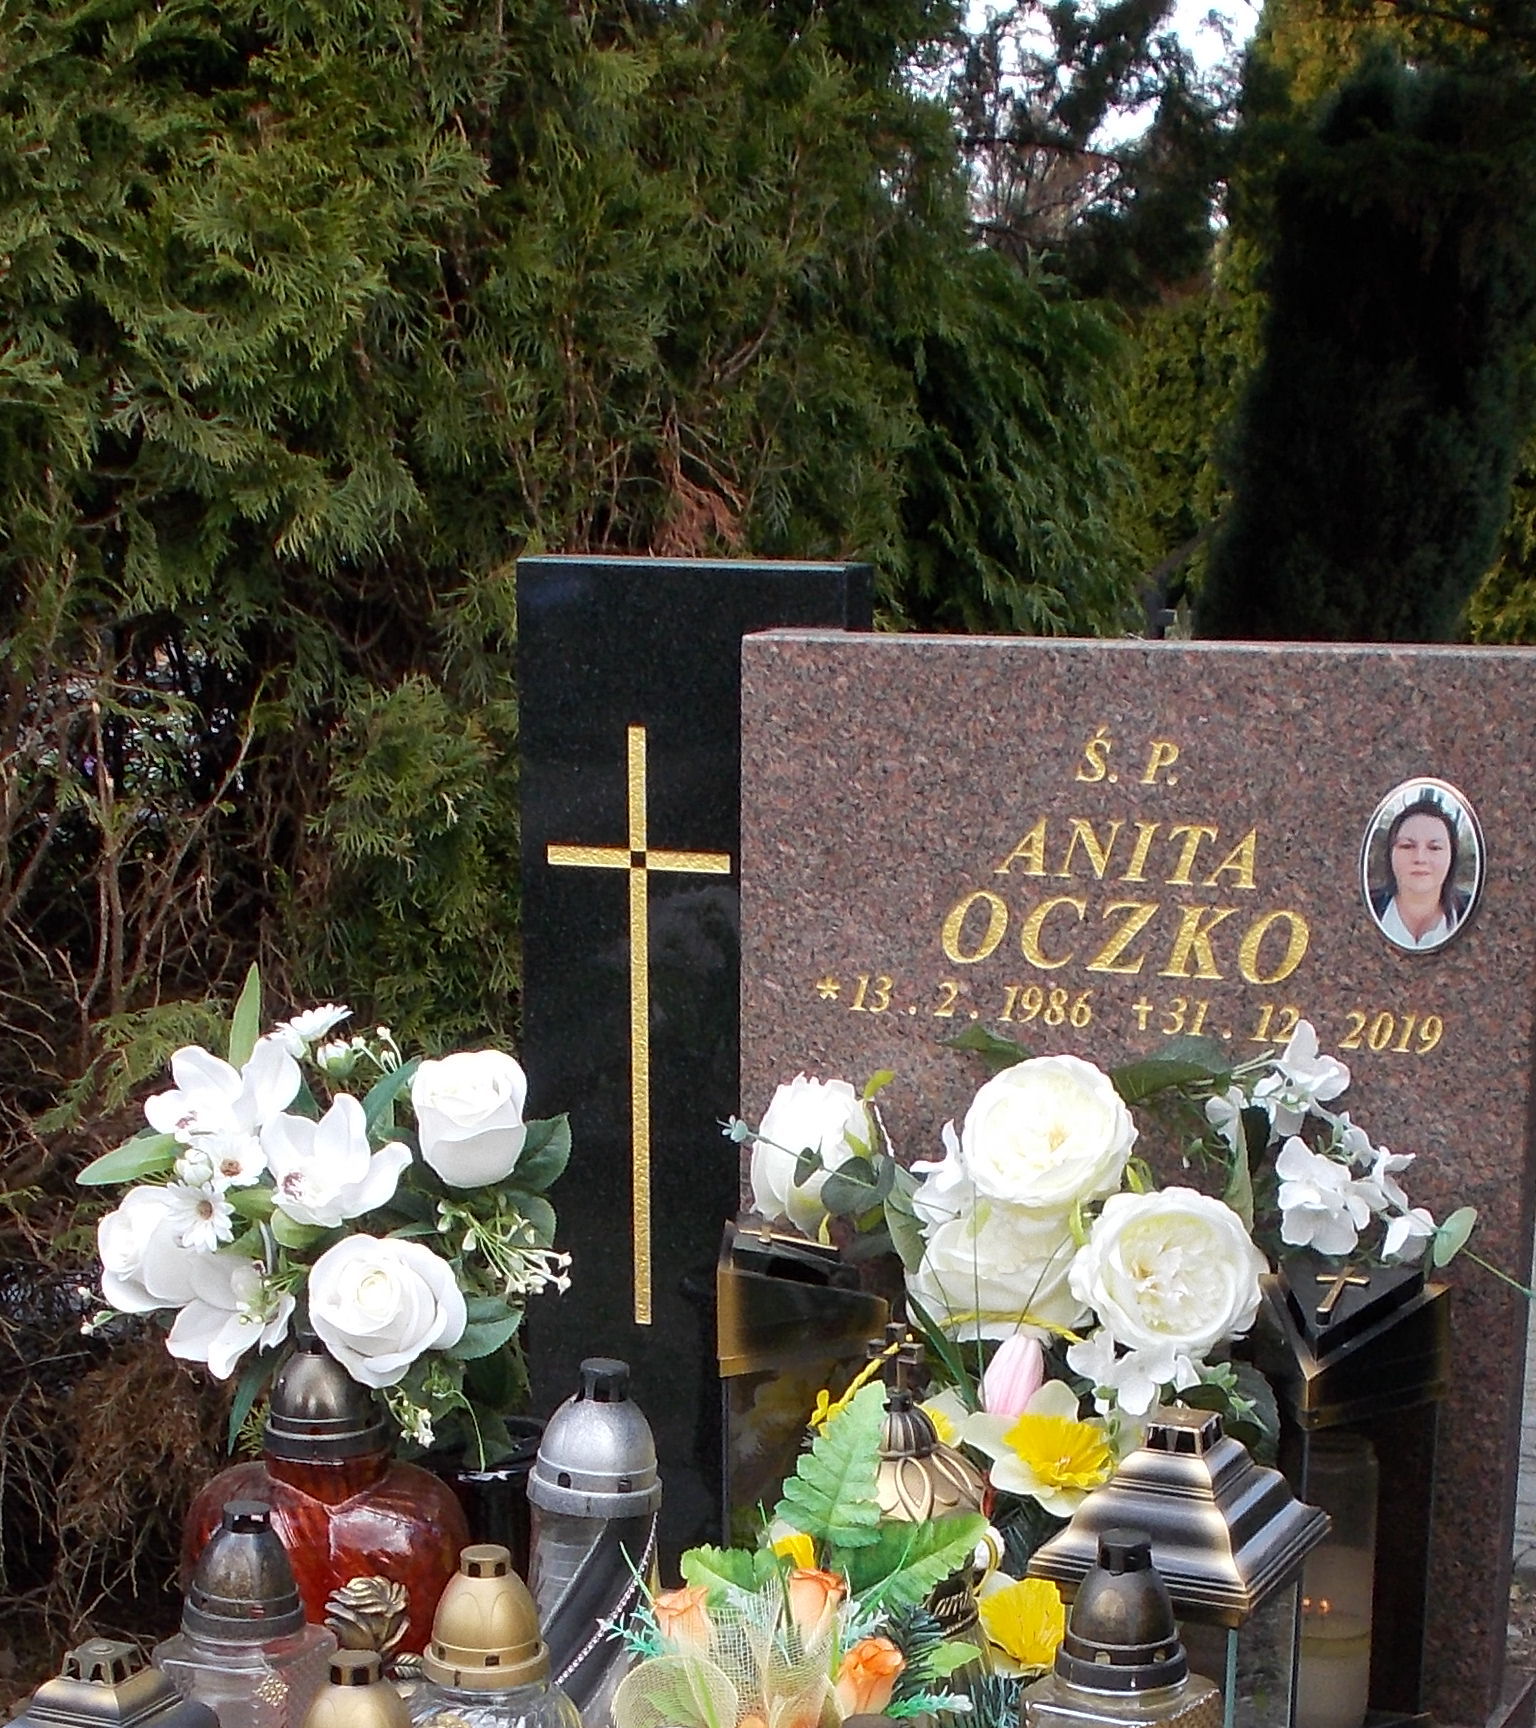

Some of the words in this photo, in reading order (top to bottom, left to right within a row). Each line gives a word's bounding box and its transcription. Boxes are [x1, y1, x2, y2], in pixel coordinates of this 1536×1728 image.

[1075, 726, 1119, 785] Ś.
[1142, 740, 1180, 787] P.
[994, 816, 1258, 890] ANITA
[940, 890, 1310, 986] OCZKO
[997, 984, 1094, 1028] 1986
[1338, 1010, 1444, 1055] 2019
